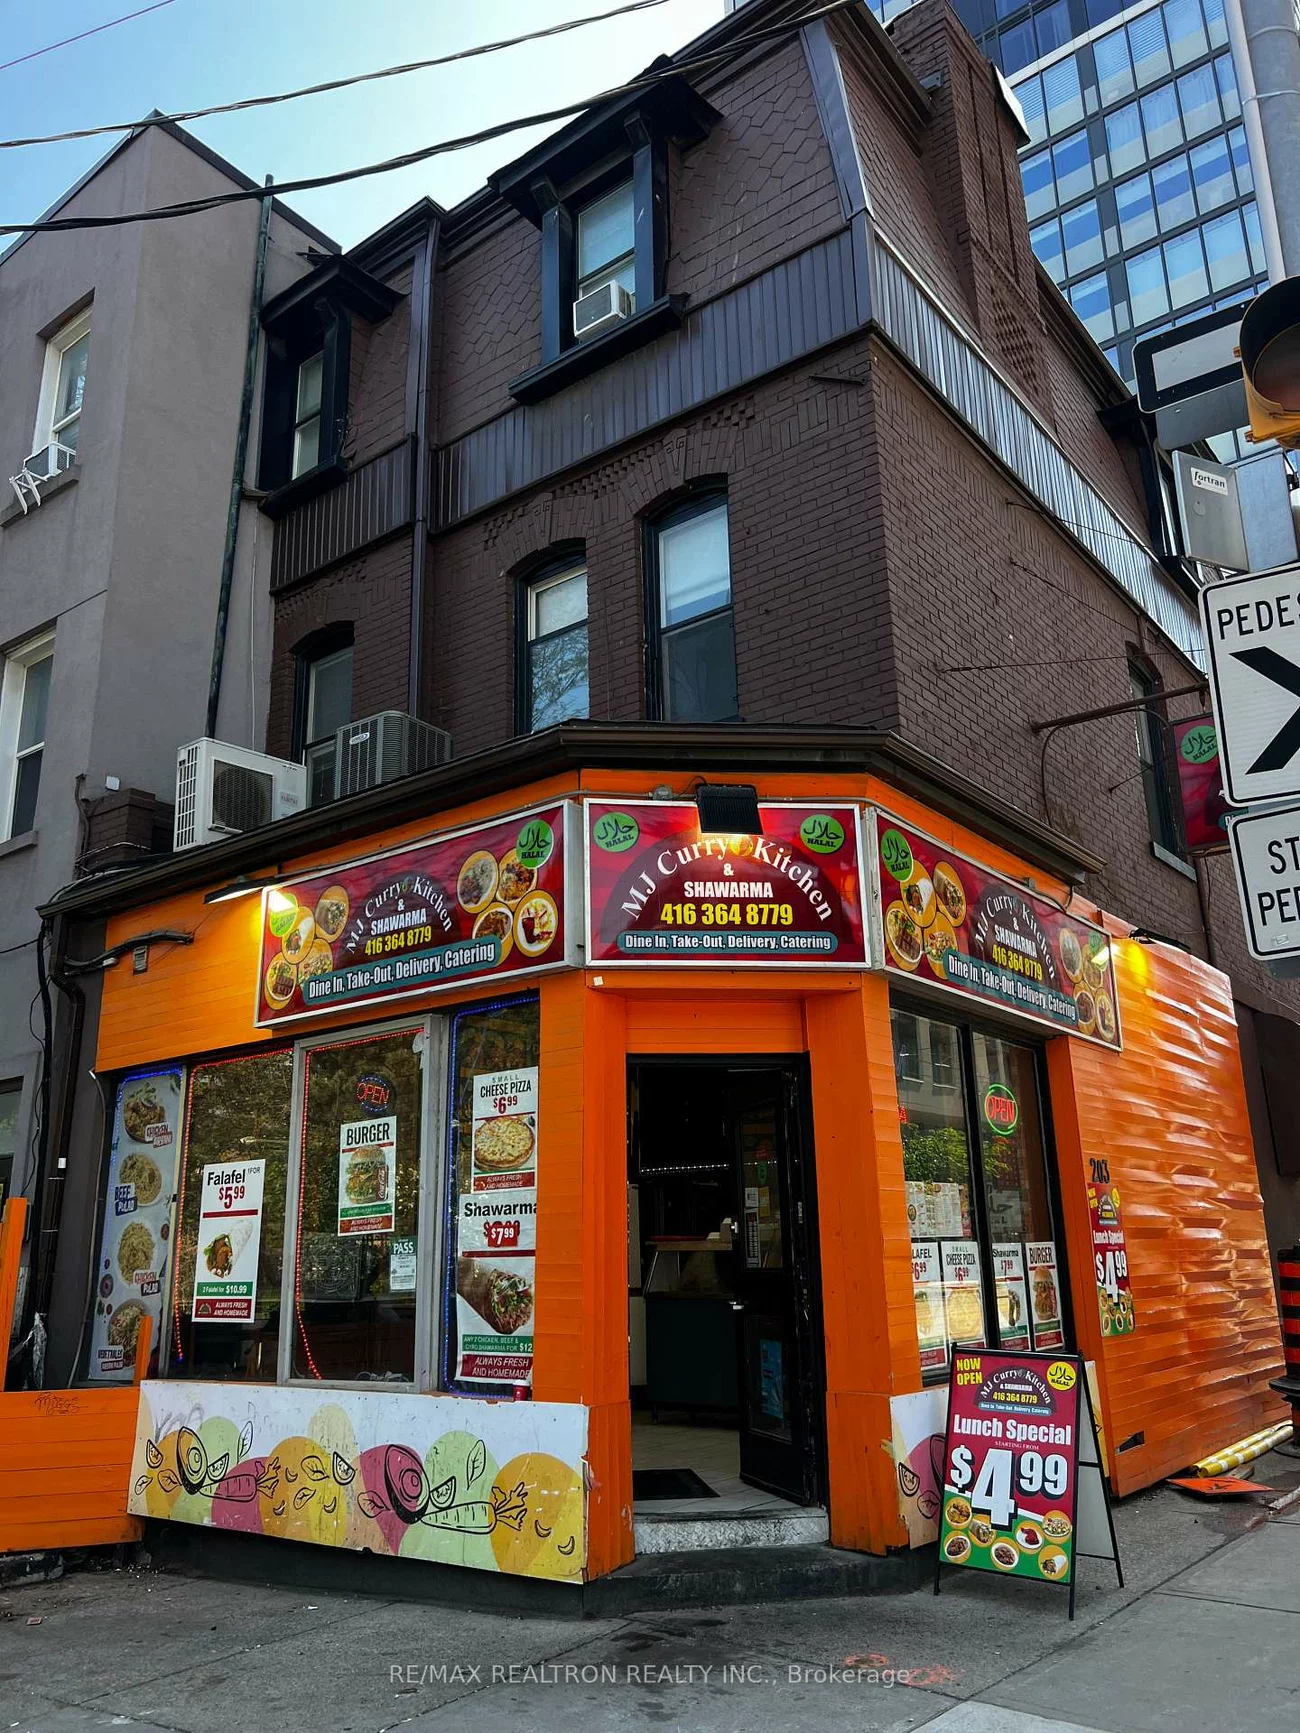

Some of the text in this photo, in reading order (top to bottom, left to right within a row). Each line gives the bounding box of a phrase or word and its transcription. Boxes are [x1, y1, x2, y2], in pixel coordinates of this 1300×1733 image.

[1194, 471, 1226, 488] fortran
[1217, 590, 1300, 641] PEDE
[597, 818, 634, 840] حلال
[804, 819, 840, 840] حلال
[519, 827, 551, 851] حلال
[605, 834, 634, 847] HALAL
[807, 837, 836, 848] HALAL
[521, 851, 545, 859] HALAL
[884, 836, 910, 863] حلال
[723, 863, 735, 877] &
[891, 862, 910, 873] HALAL
[620, 836, 833, 922] MJ Curry Kitchen
[683, 881, 774, 898] SHAWARMA
[397, 898, 405, 912] &
[346, 876, 453, 954] MJ Curry Kitchen
[370, 908, 427, 936] SHAWARMA
[660, 904, 794, 925] 416 364 8779
[1013, 917, 1019, 931] &
[364, 925, 432, 956] 416 364 8779
[625, 935, 831, 951] Dine In, Take-Out, Delivery, Catering
[986, 895, 1013, 918] Curry
[1022, 903, 1056, 979] Kitchen
[994, 924, 1038, 958] SHAWARMA
[309, 942, 495, 999] Dine In, Take-Out, Delivery, Catering
[992, 944, 1043, 981] 416 364 8779
[948, 954, 1076, 1021] Dine In, Take-Out, Delivery, Catering
[492, 1074, 519, 1083] SMALL
[356, 1082, 390, 1104] OPEN
[480, 1079, 532, 1098] CHEESE PIZZA
[986, 1096, 1015, 1123] OPEN
[346, 1123, 390, 1147] BURGER
[207, 1169, 246, 1186] Falafel
[1089, 1157, 1110, 1184] 203
[393, 1241, 414, 1254] PASS
[992, 1248, 1019, 1258] Shawarma
[1029, 1247, 1053, 1264] BURGER
[946, 1253, 976, 1266] CHEESE PIZZA
[225, 1284, 247, 1294] $10.99
[233, 1301, 248, 1309] FRESH
[519, 1343, 533, 1352] $12
[475, 1356, 529, 1367] ALWAYS FRESH
[956, 1357, 981, 1371] NOW
[472, 1367, 530, 1379] AND HOMEMADE
[956, 1372, 983, 1386] OPEN
[1049, 1365, 1074, 1381] حلال
[980, 1369, 1052, 1405] MJ Curry Kitchen
[1051, 1378, 1070, 1387] HALAL
[993, 1391, 1038, 1404] 416 364 8779
[953, 1414, 1072, 1445] Lunch Special
[994, 1440, 1022, 1449] STARTING
